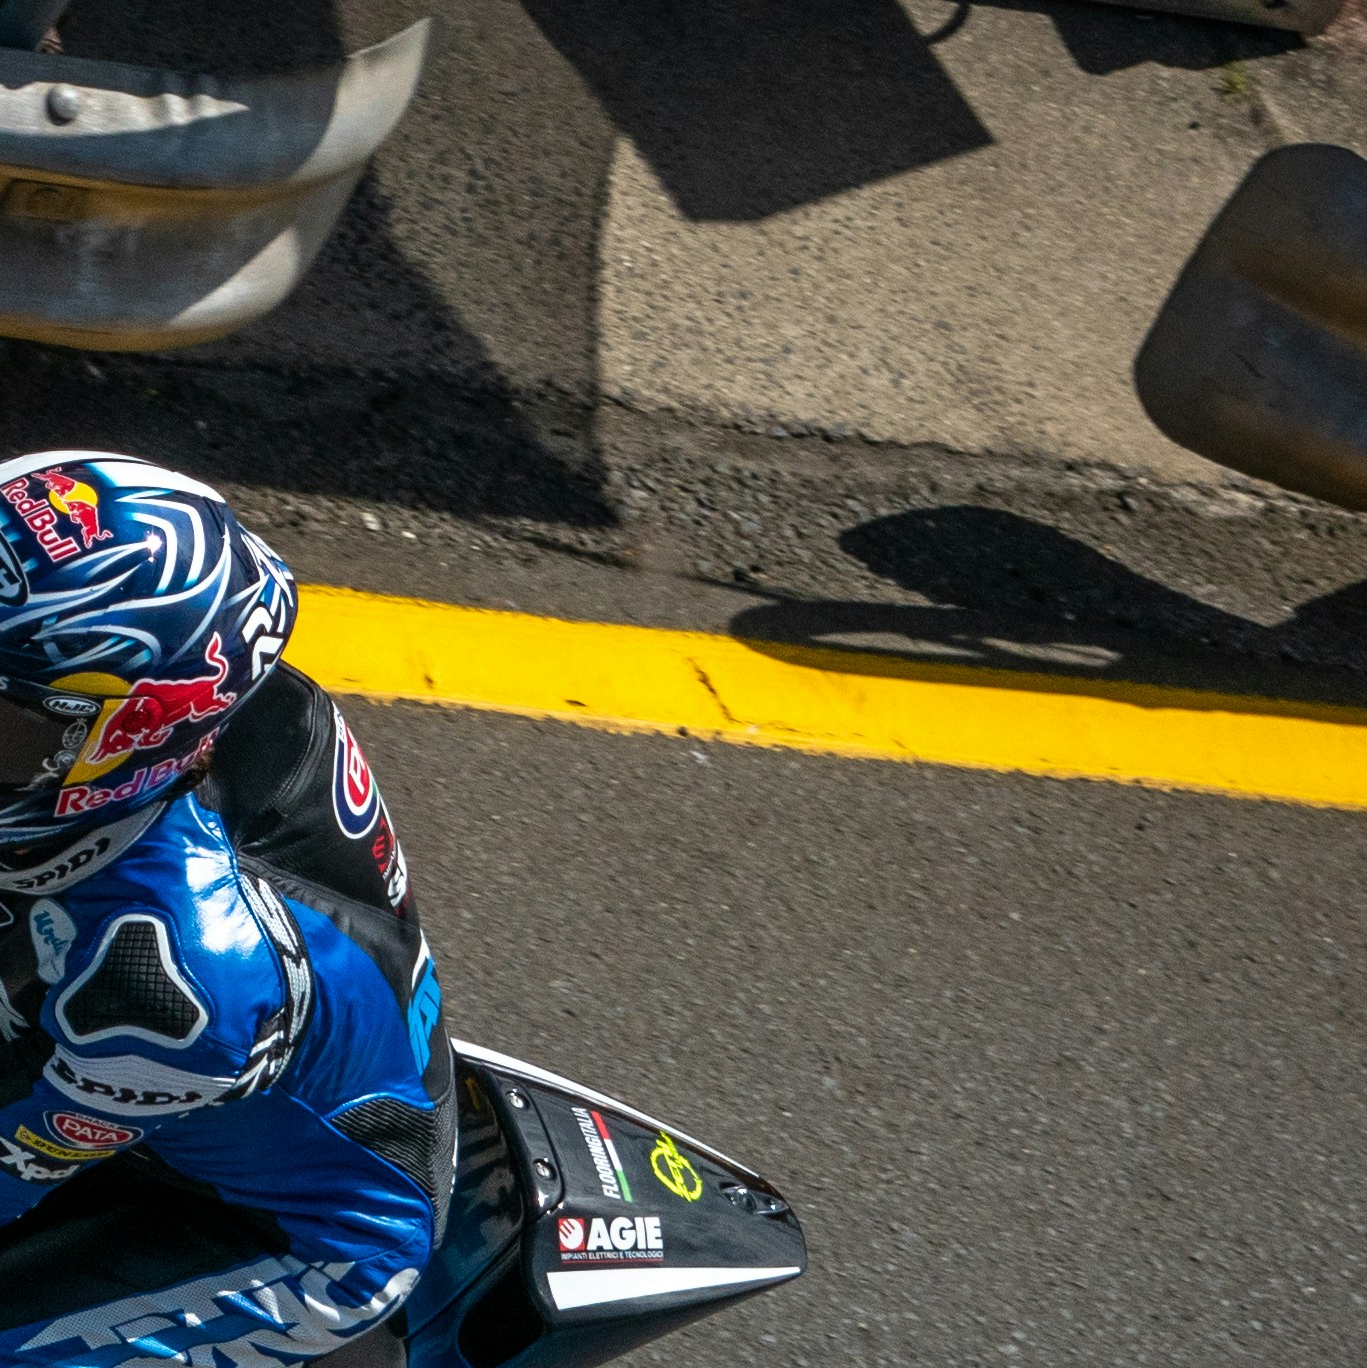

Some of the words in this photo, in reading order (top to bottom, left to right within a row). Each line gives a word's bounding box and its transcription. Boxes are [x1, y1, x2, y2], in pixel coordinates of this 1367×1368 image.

[0, 477, 49, 517] Red
[24, 506, 81, 562] Bull
[49, 700, 97, 713] HJC
[53, 767, 147, 817] Red
[12, 837, 111, 890] SPIDI
[61, 1118, 119, 1142] PATA
[32, 1139, 113, 1158] DUNLOP
[587, 1216, 664, 1250] AGIE
[561, 1252, 587, 1260] IMPIANTI
[588, 1251, 619, 1260] ELETTRICI
[624, 1251, 664, 1259] TECNOLOGICI
